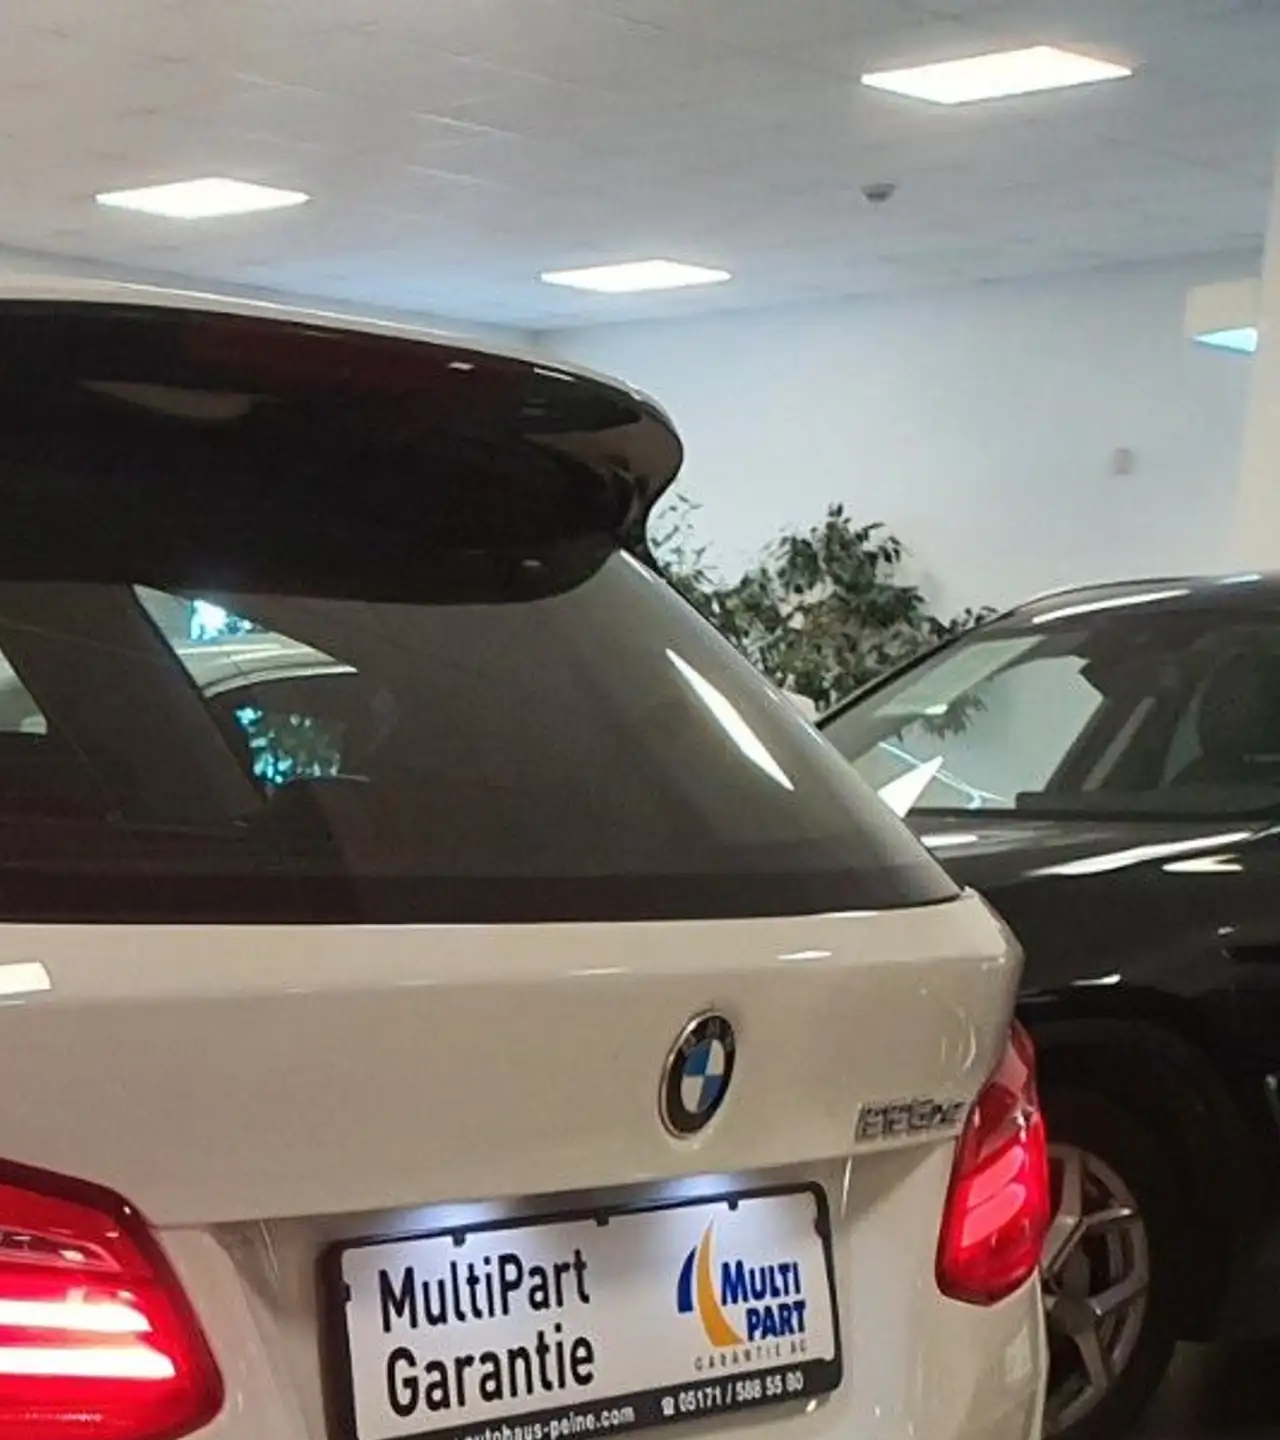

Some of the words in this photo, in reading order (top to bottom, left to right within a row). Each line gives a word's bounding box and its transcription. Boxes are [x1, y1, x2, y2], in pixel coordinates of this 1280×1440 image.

[378, 1249, 590, 1333] MultiPart
[745, 1300, 806, 1342] PART
[387, 1322, 594, 1417] Garantie
[694, 1342, 781, 1372] GARANTIE
[678, 1384, 722, 1412] 05171
[765, 1374, 783, 1396] 55
